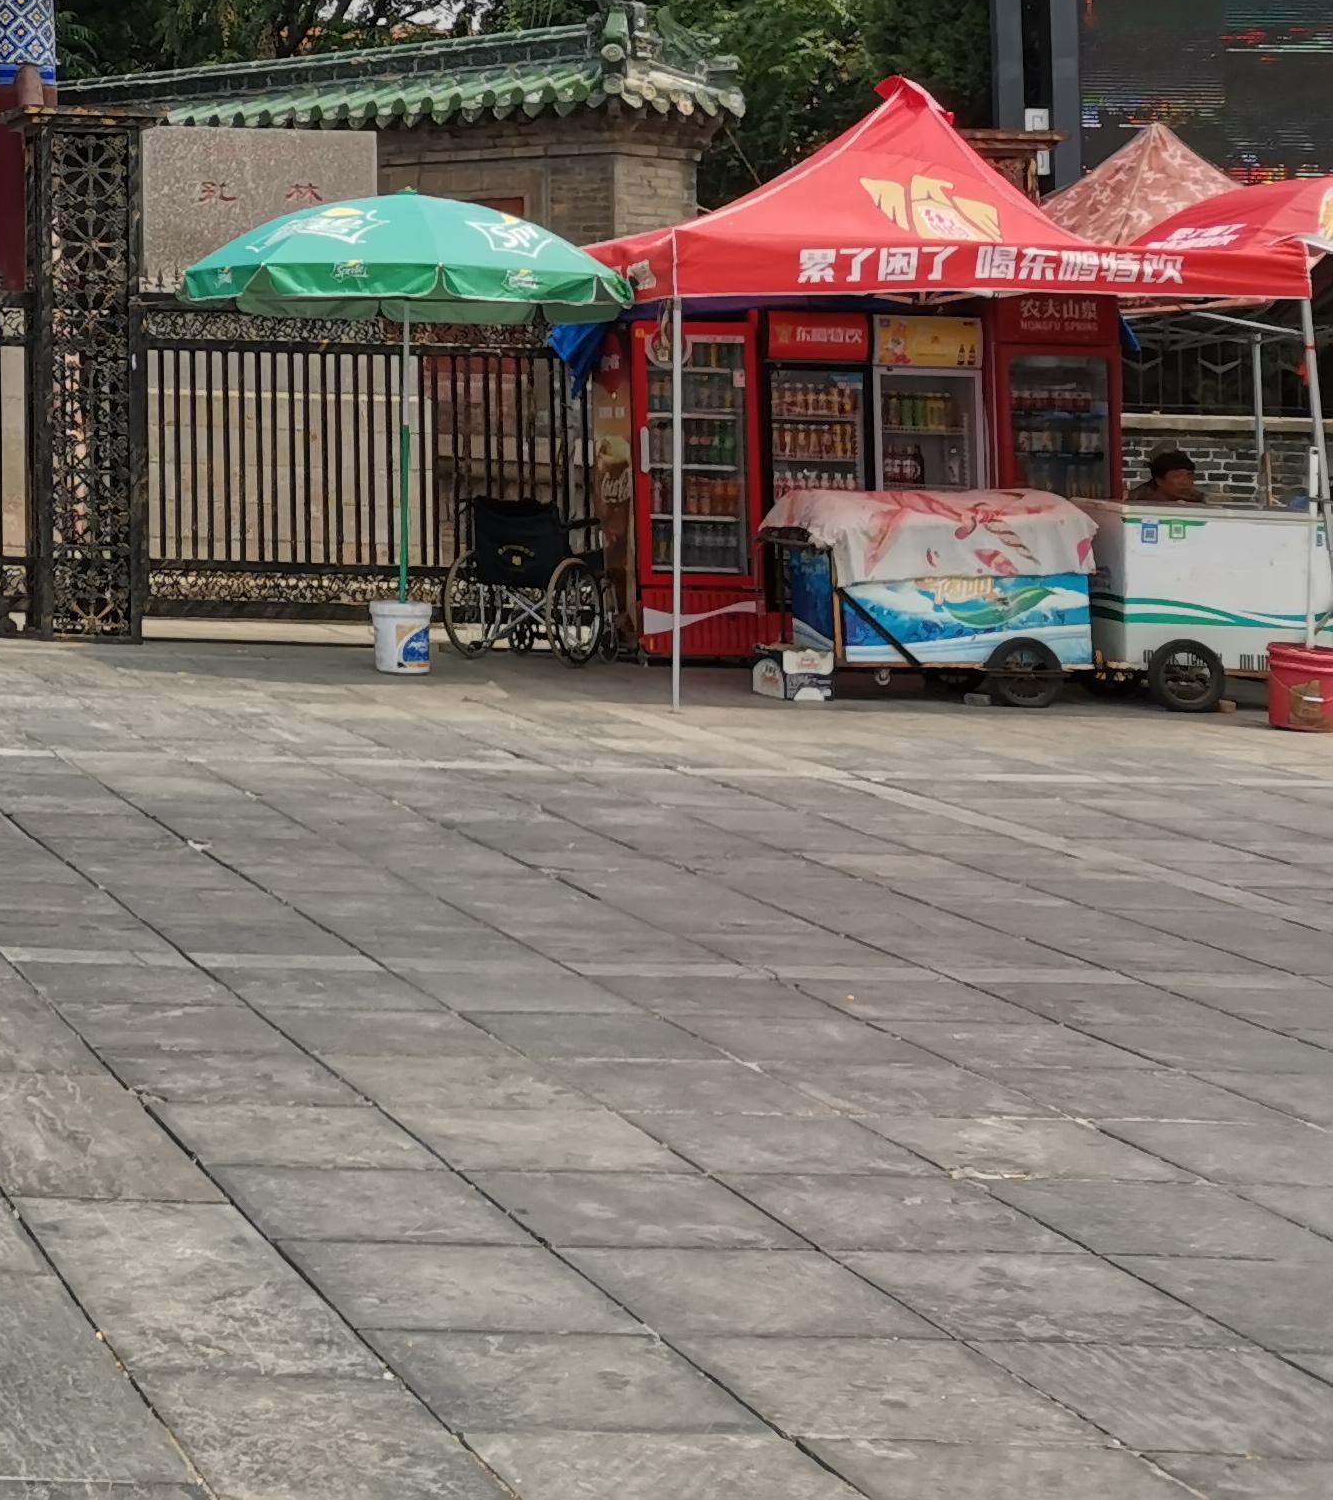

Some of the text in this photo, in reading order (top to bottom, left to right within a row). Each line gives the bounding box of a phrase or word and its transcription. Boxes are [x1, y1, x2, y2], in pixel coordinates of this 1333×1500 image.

[798, 245, 1185, 285] 累了困了 喝东鹏特饮
[1020, 299, 1098, 319] 农夫山泉
